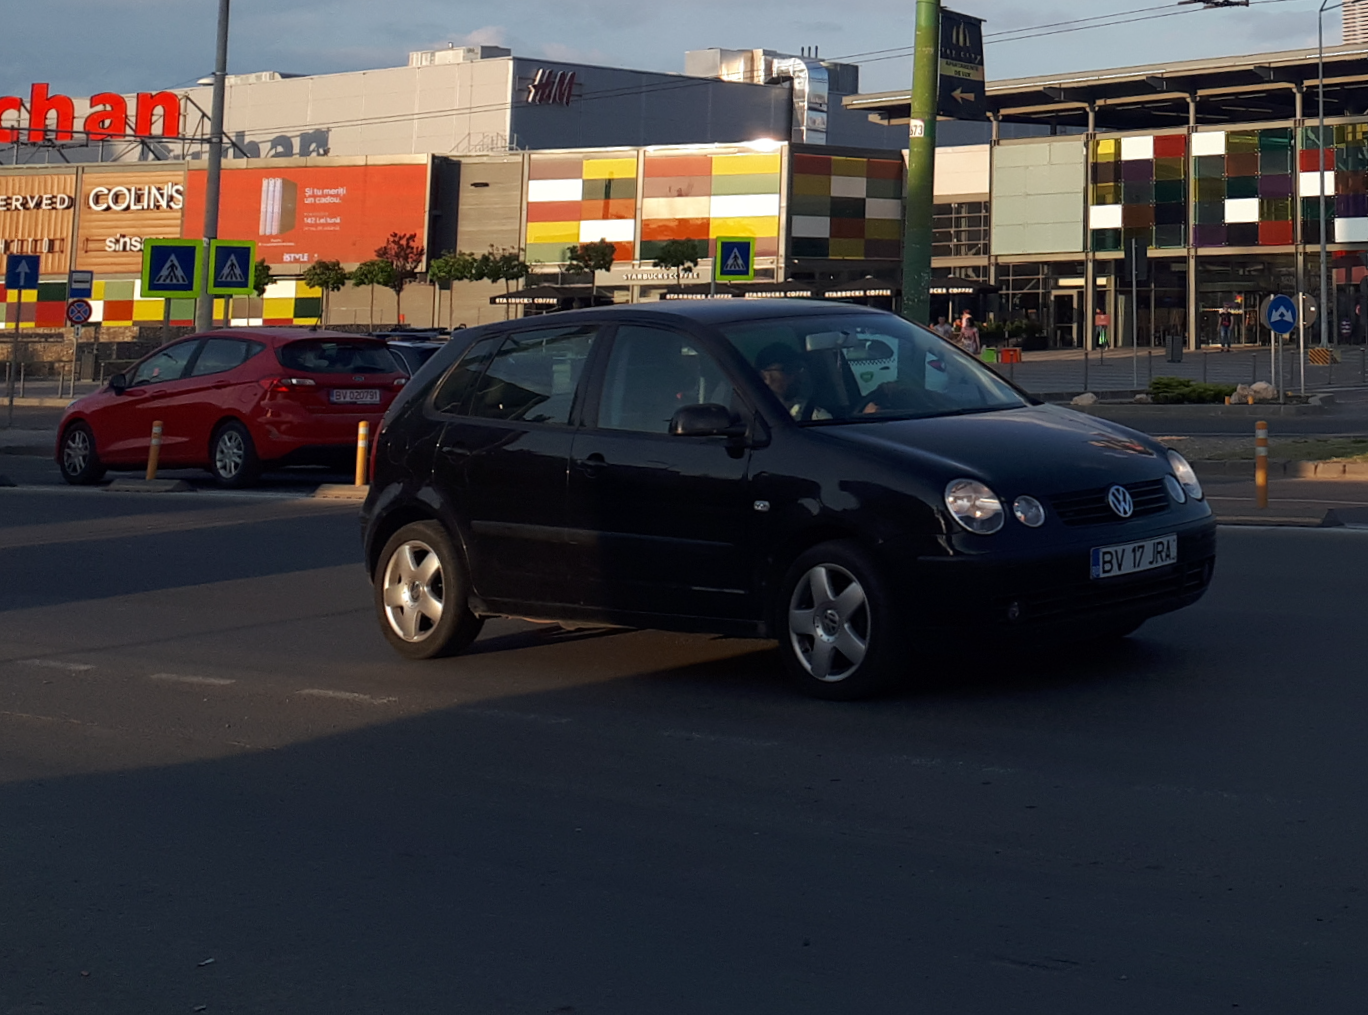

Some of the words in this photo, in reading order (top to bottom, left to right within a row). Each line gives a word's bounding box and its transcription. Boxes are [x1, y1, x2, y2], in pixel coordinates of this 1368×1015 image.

[527, 68, 576, 106] H&M
[89, 182, 184, 211] COLIN'S
[622, 272, 668, 281] STARBUCKS
[824, 290, 864, 298] STARBUCKS
[335, 390, 347, 400] BV
[1102, 548, 1125, 574] BV
[1131, 545, 1145, 569] 17
[1149, 539, 1171, 565] JRA
